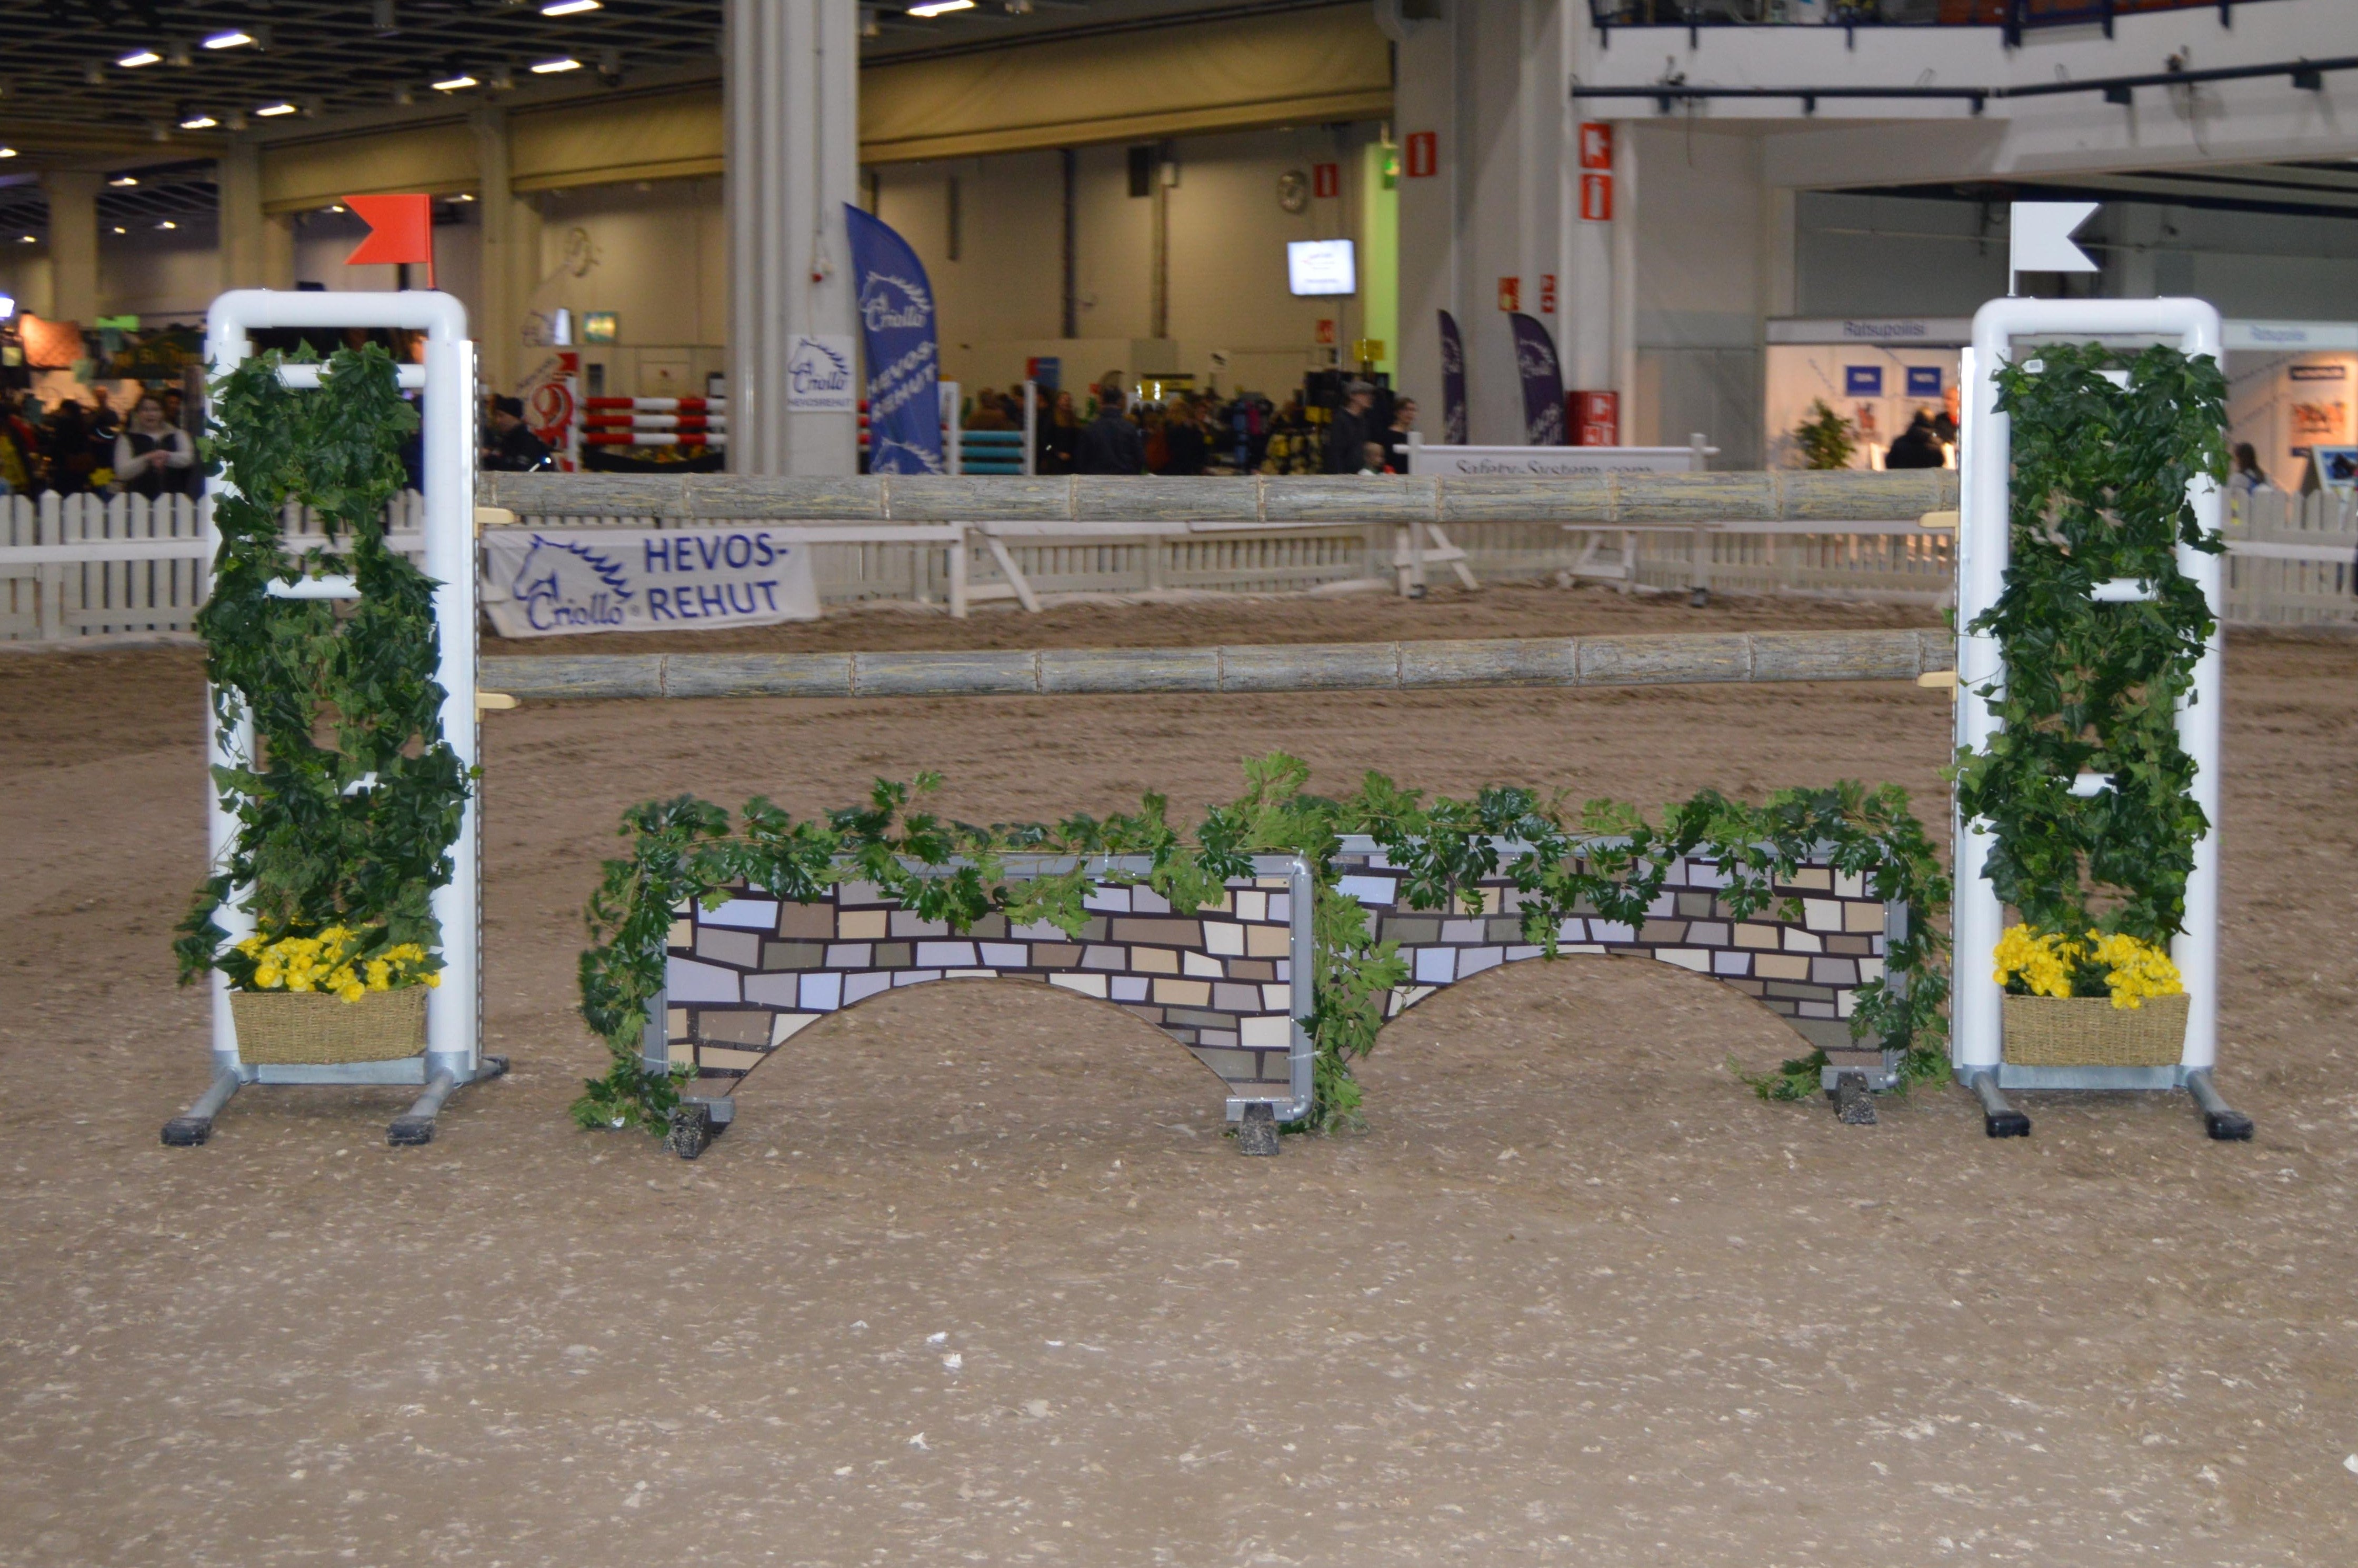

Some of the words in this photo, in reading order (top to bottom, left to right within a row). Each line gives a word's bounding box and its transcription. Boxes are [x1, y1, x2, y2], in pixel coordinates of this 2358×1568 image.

[644, 533, 788, 573] HEVOS-
[528, 591, 625, 630] Criollo
[648, 581, 778, 621] REHUT
